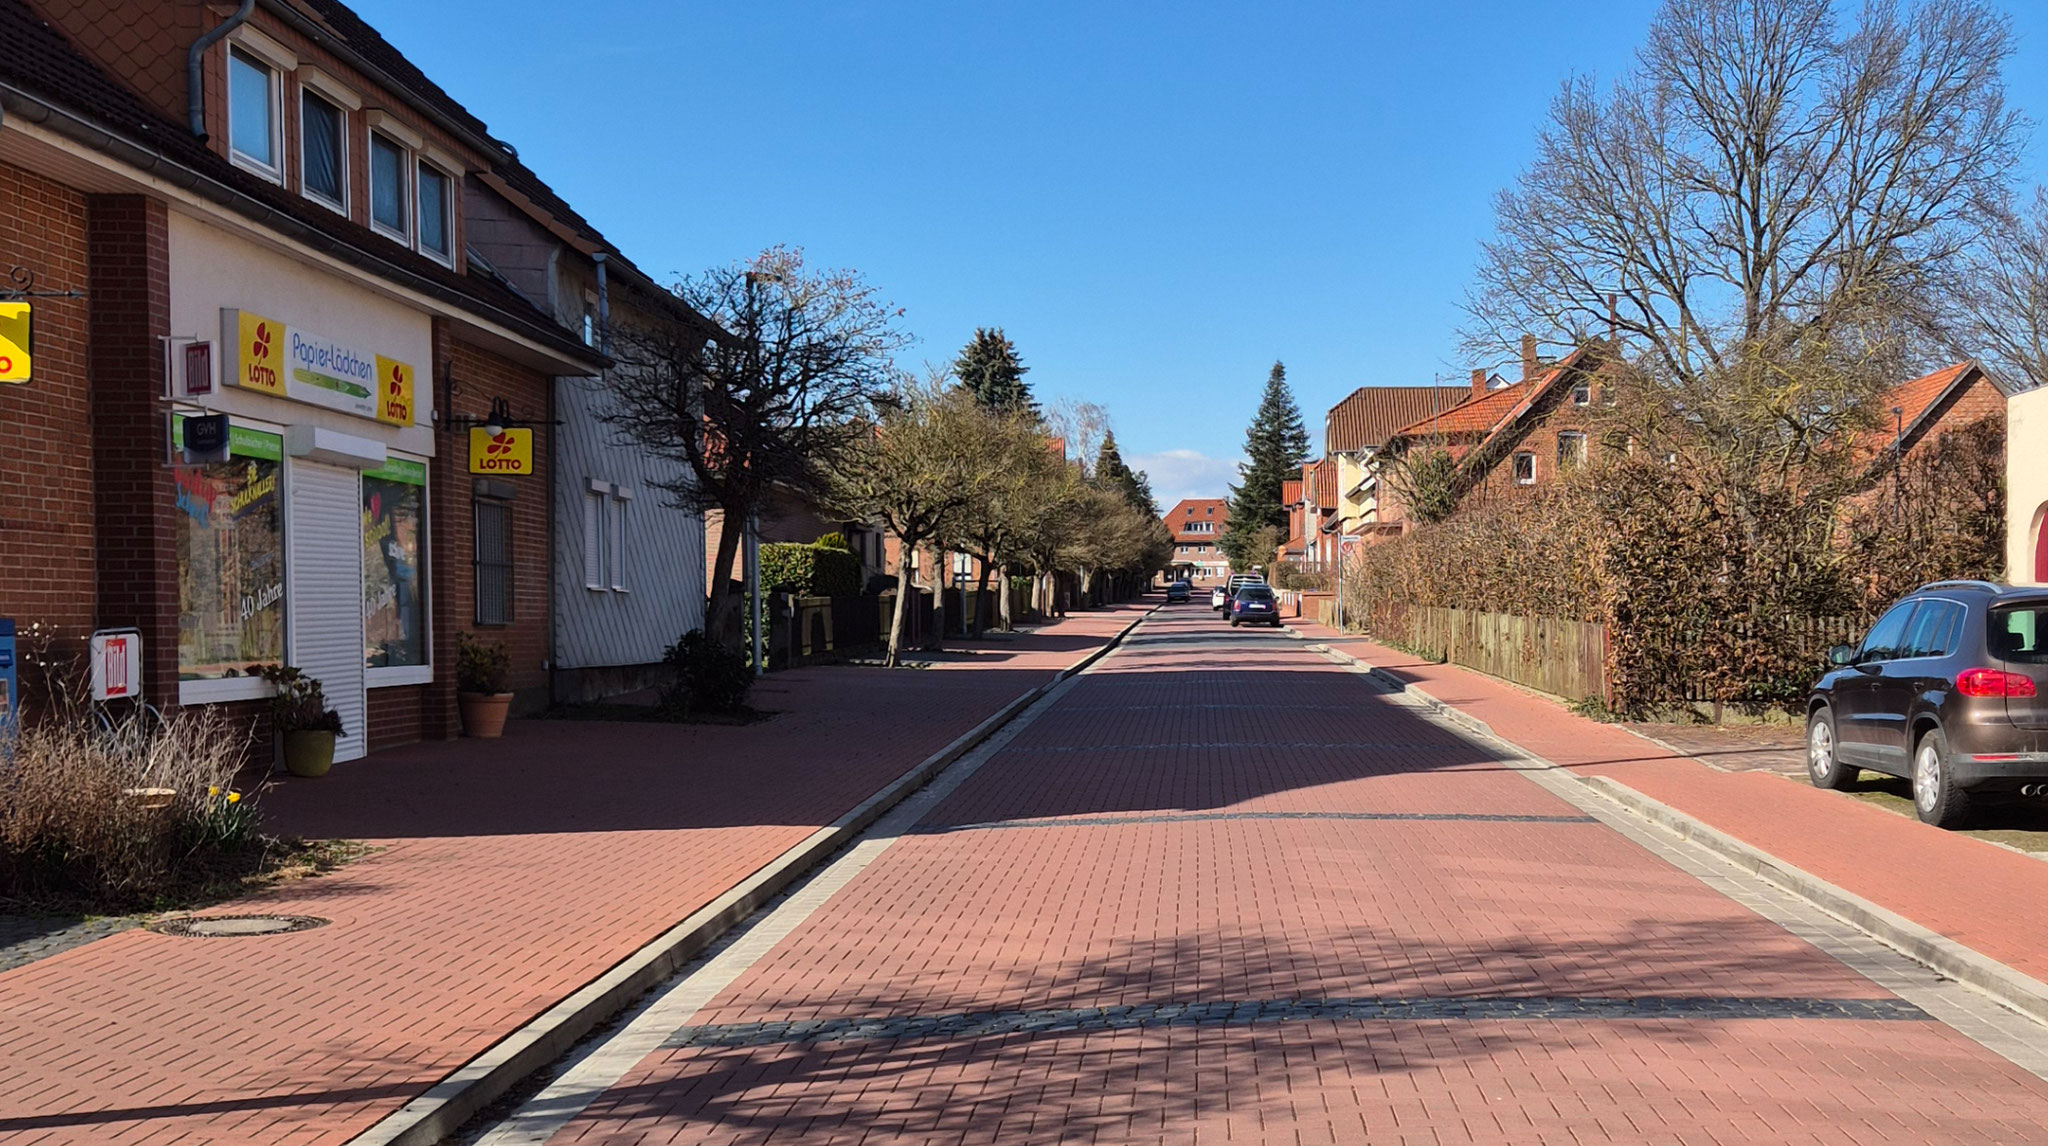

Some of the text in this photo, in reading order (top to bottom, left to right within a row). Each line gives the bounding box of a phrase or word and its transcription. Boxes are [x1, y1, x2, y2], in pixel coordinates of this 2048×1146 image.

[188, 349, 208, 388] Bild
[248, 363, 276, 387] LOTTO
[293, 332, 372, 381] Papier-Lädchen
[196, 422, 217, 436] GVH
[386, 400, 407, 421] LOTTO
[480, 458, 522, 470] LOTTO
[241, 582, 283, 620] 40 Jahre
[366, 583, 397, 620] 40 Jahre
[107, 645, 126, 688] Bild
